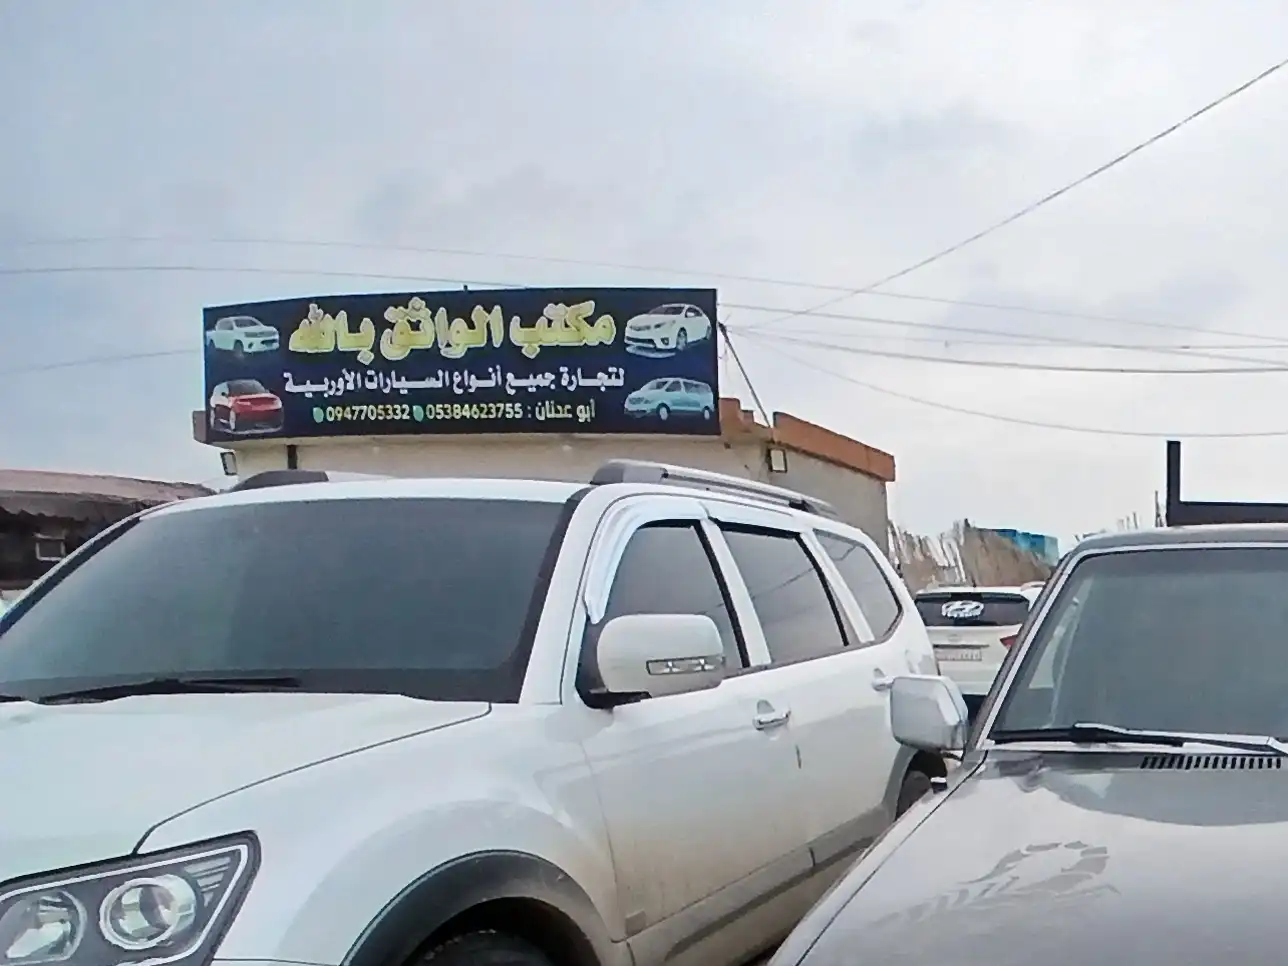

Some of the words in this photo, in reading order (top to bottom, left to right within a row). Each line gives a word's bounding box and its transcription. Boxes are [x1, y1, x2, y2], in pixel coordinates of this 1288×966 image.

[289, 303, 375, 365] بالله
[380, 296, 504, 361] الواثق
[510, 300, 616, 358] مكتب
[283, 368, 361, 397] الأوربية
[364, 369, 450, 395] السيارات
[453, 365, 502, 394] أنواع
[505, 372, 555, 395] جميع
[559, 366, 625, 392] لتجارة
[326, 404, 410, 421] 0947705332
[426, 403, 523, 420] 05384623755
[535, 399, 573, 421] عدنان
[576, 398, 596, 422] أبو
